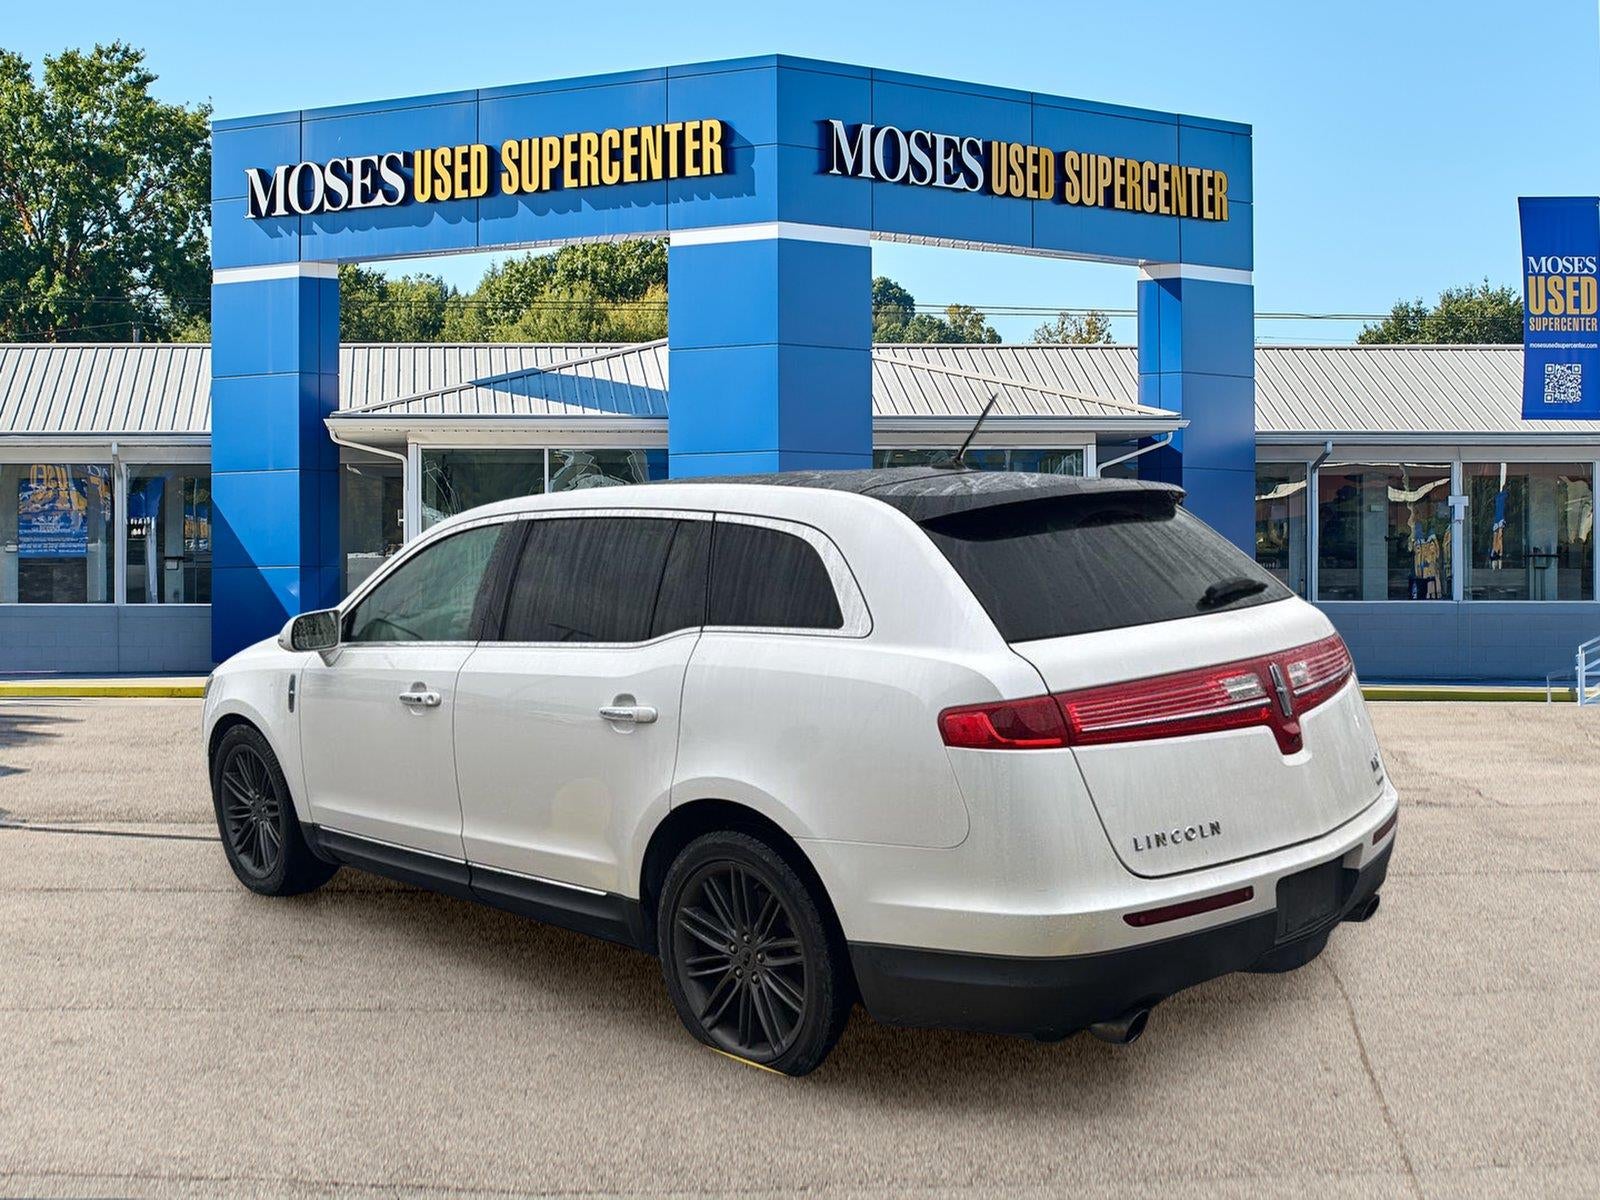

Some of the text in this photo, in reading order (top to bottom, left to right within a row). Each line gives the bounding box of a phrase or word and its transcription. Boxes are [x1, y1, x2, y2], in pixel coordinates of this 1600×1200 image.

[244, 118, 725, 220] MOSES USED SUPERCENTER
[828, 118, 1230, 222] MOSES USED SUPERCENTER
[1527, 256, 1597, 275] MOSES
[1528, 275, 1598, 316] USED
[1529, 316, 1598, 332] SUPERCENTER
[1132, 820, 1222, 852] LINCOLN
